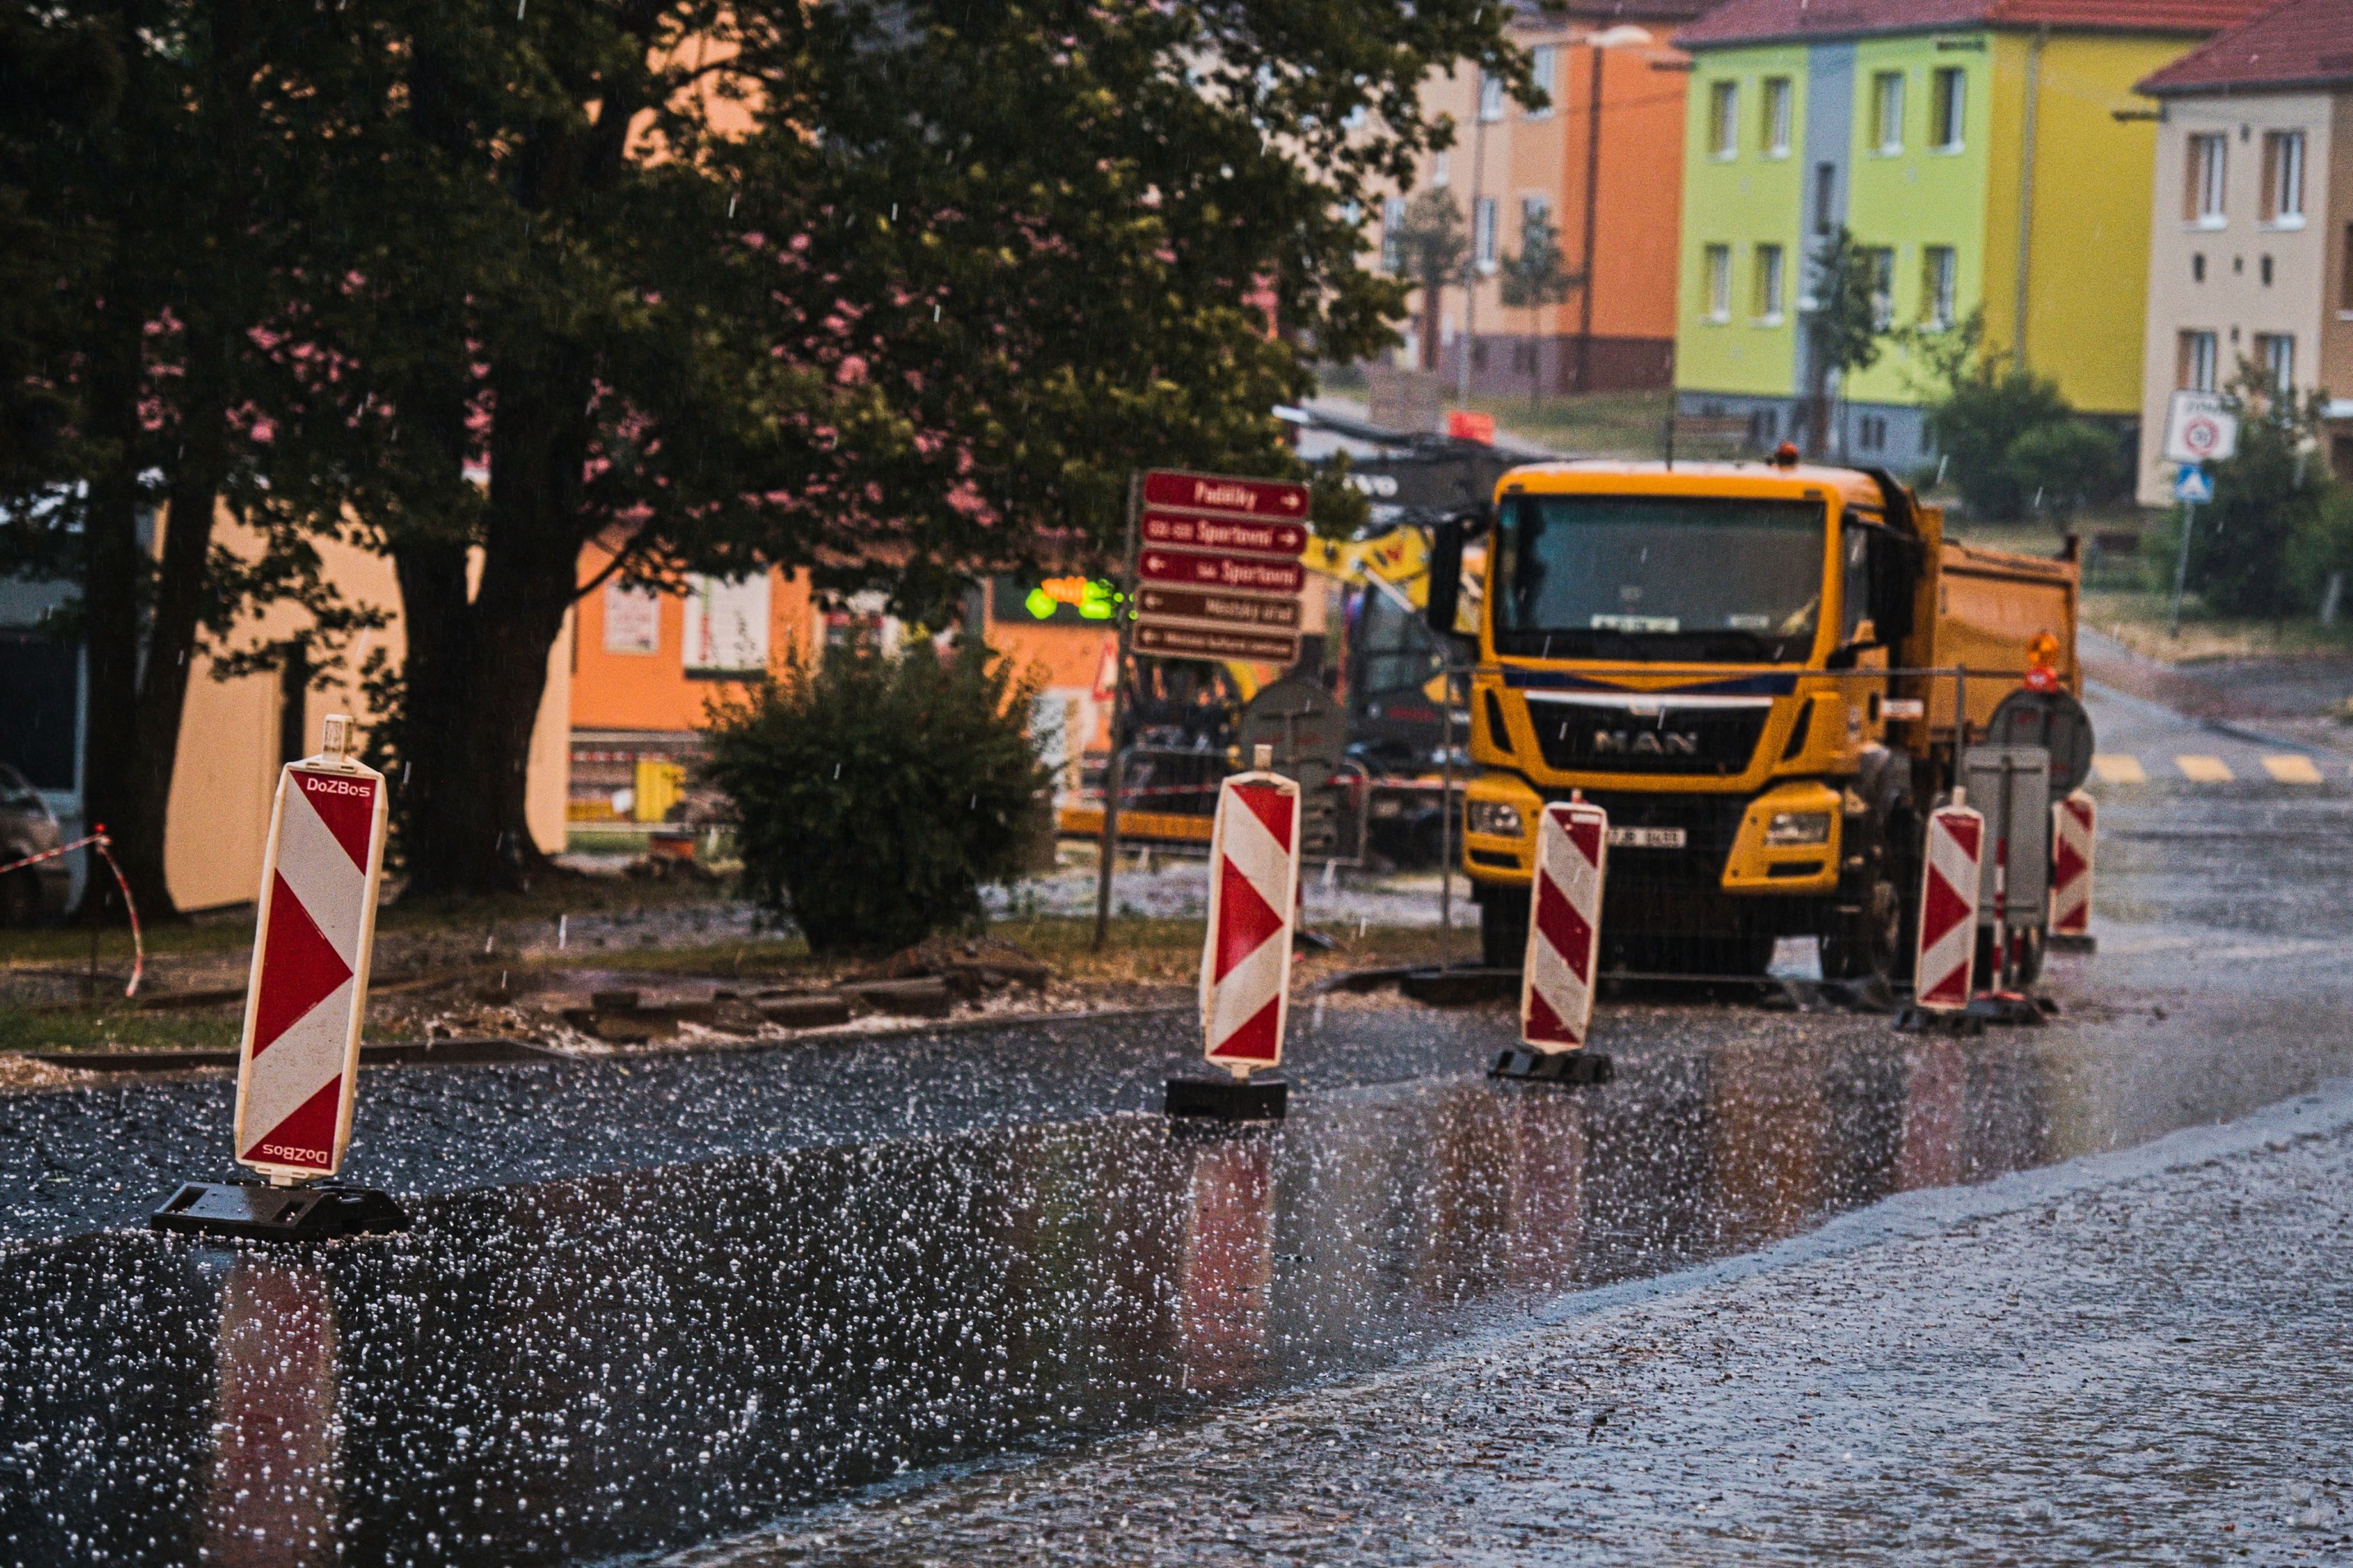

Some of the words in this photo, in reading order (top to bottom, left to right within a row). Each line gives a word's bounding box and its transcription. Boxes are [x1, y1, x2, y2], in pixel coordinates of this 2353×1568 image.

[1594, 730, 1698, 755] MAN
[306, 778, 371, 797] DoZBos
[262, 1144, 328, 1164] DoZBos
